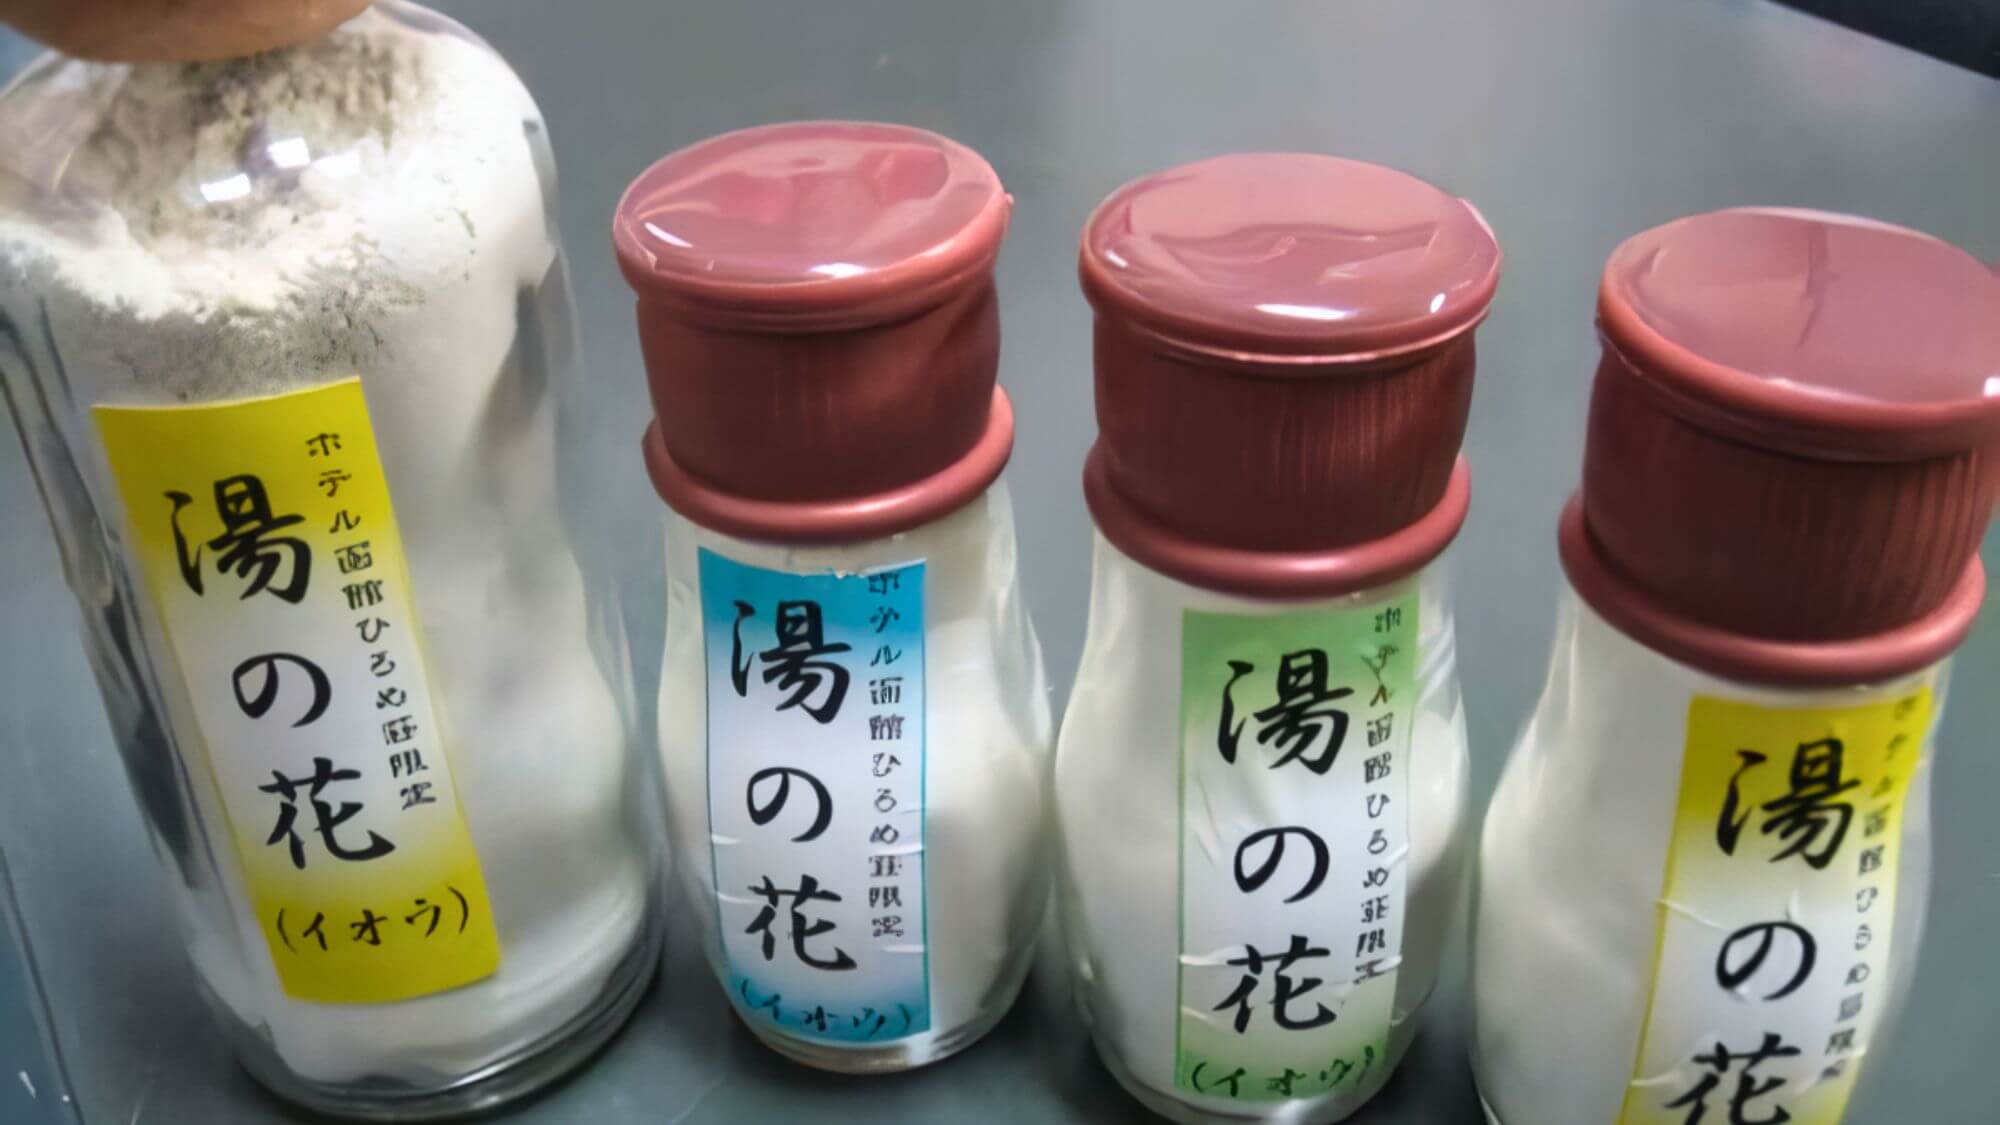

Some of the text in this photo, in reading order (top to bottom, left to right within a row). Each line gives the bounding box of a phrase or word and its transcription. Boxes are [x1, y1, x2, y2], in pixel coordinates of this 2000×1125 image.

[162, 474, 396, 869] 湯の花
[731, 600, 857, 971] 湯の花
[1212, 648, 1355, 1033] 湯の花
[1663, 737, 1861, 1125] 湯の花
